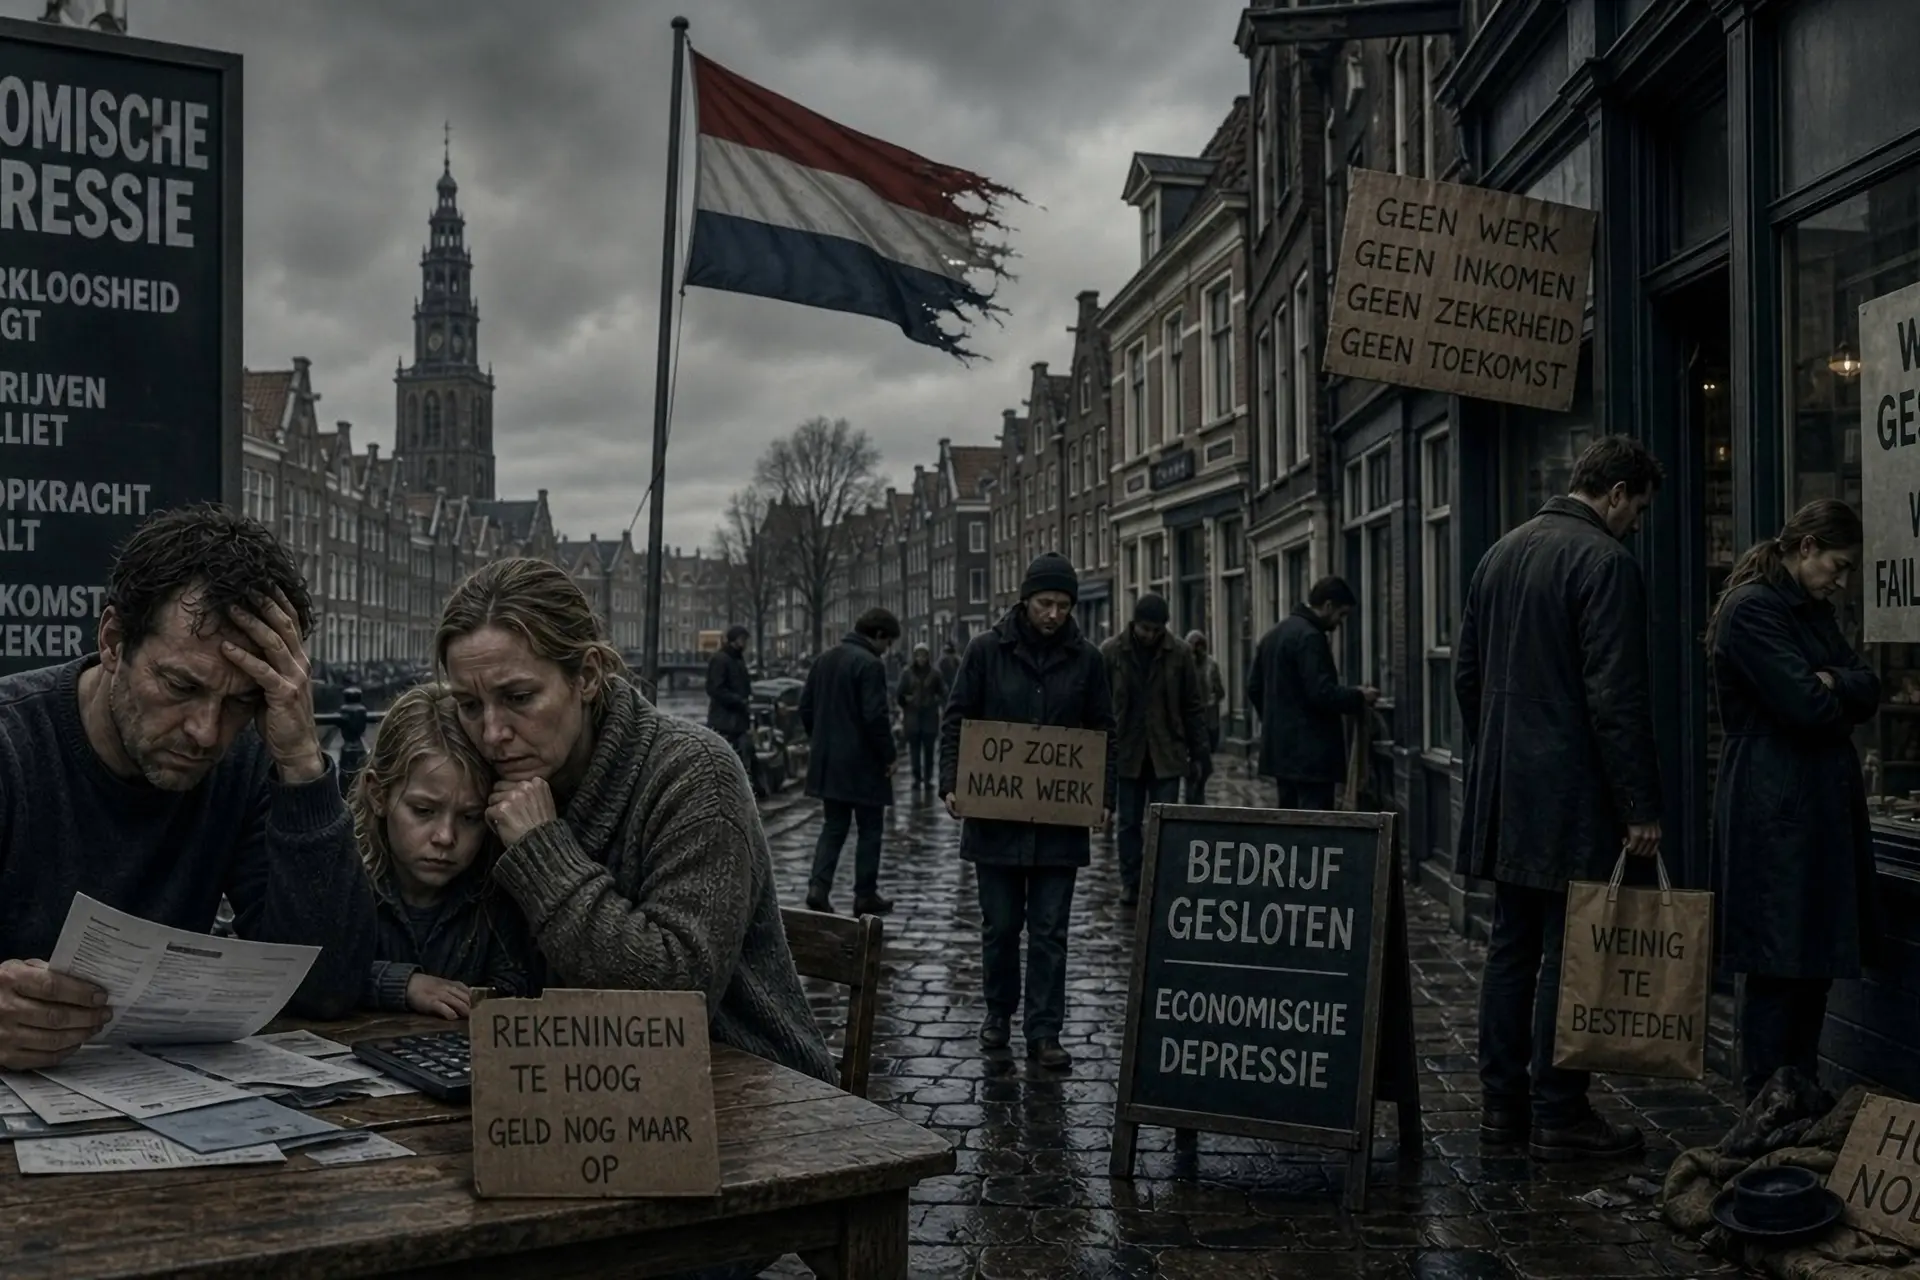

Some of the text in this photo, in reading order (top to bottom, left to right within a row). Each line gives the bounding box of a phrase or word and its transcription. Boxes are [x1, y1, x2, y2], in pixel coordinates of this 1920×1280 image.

[0, 75, 209, 171] OMISCHE
[0, 157, 195, 249] RESSIE
[1376, 197, 1561, 255] GEEN WERK
[1355, 239, 1576, 302] GEEN INKOMEN
[1347, 283, 1574, 346] GEEN ZEKERHEID
[1340, 327, 1568, 390] GEEN TOEKOMST
[0, 370, 106, 410] RIJVEN
[0, 411, 69, 447] LIET
[1876, 388, 1920, 452] GE
[0, 477, 151, 516] PKRACHT
[0, 583, 106, 618] KOMST
[0, 624, 83, 657] EKER
[982, 737, 1083, 769] OP ZOEK
[968, 771, 1093, 806] NAAR WERK
[1187, 839, 1344, 891] BEDRIJF
[1167, 896, 1354, 951] GESLOTEN
[1591, 924, 1685, 960] WEINIG
[1618, 969, 1651, 997] TE
[493, 1014, 685, 1049] REKENINGEN
[1155, 987, 1348, 1037] ECONOMISCHE
[1571, 1003, 1693, 1042] BESTEDEN
[510, 1063, 641, 1093] TE HOOG
[1159, 1036, 1329, 1090] DEPRESSIE
[488, 1116, 692, 1149] GELD NOG MAAR
[582, 1155, 619, 1184] OP
